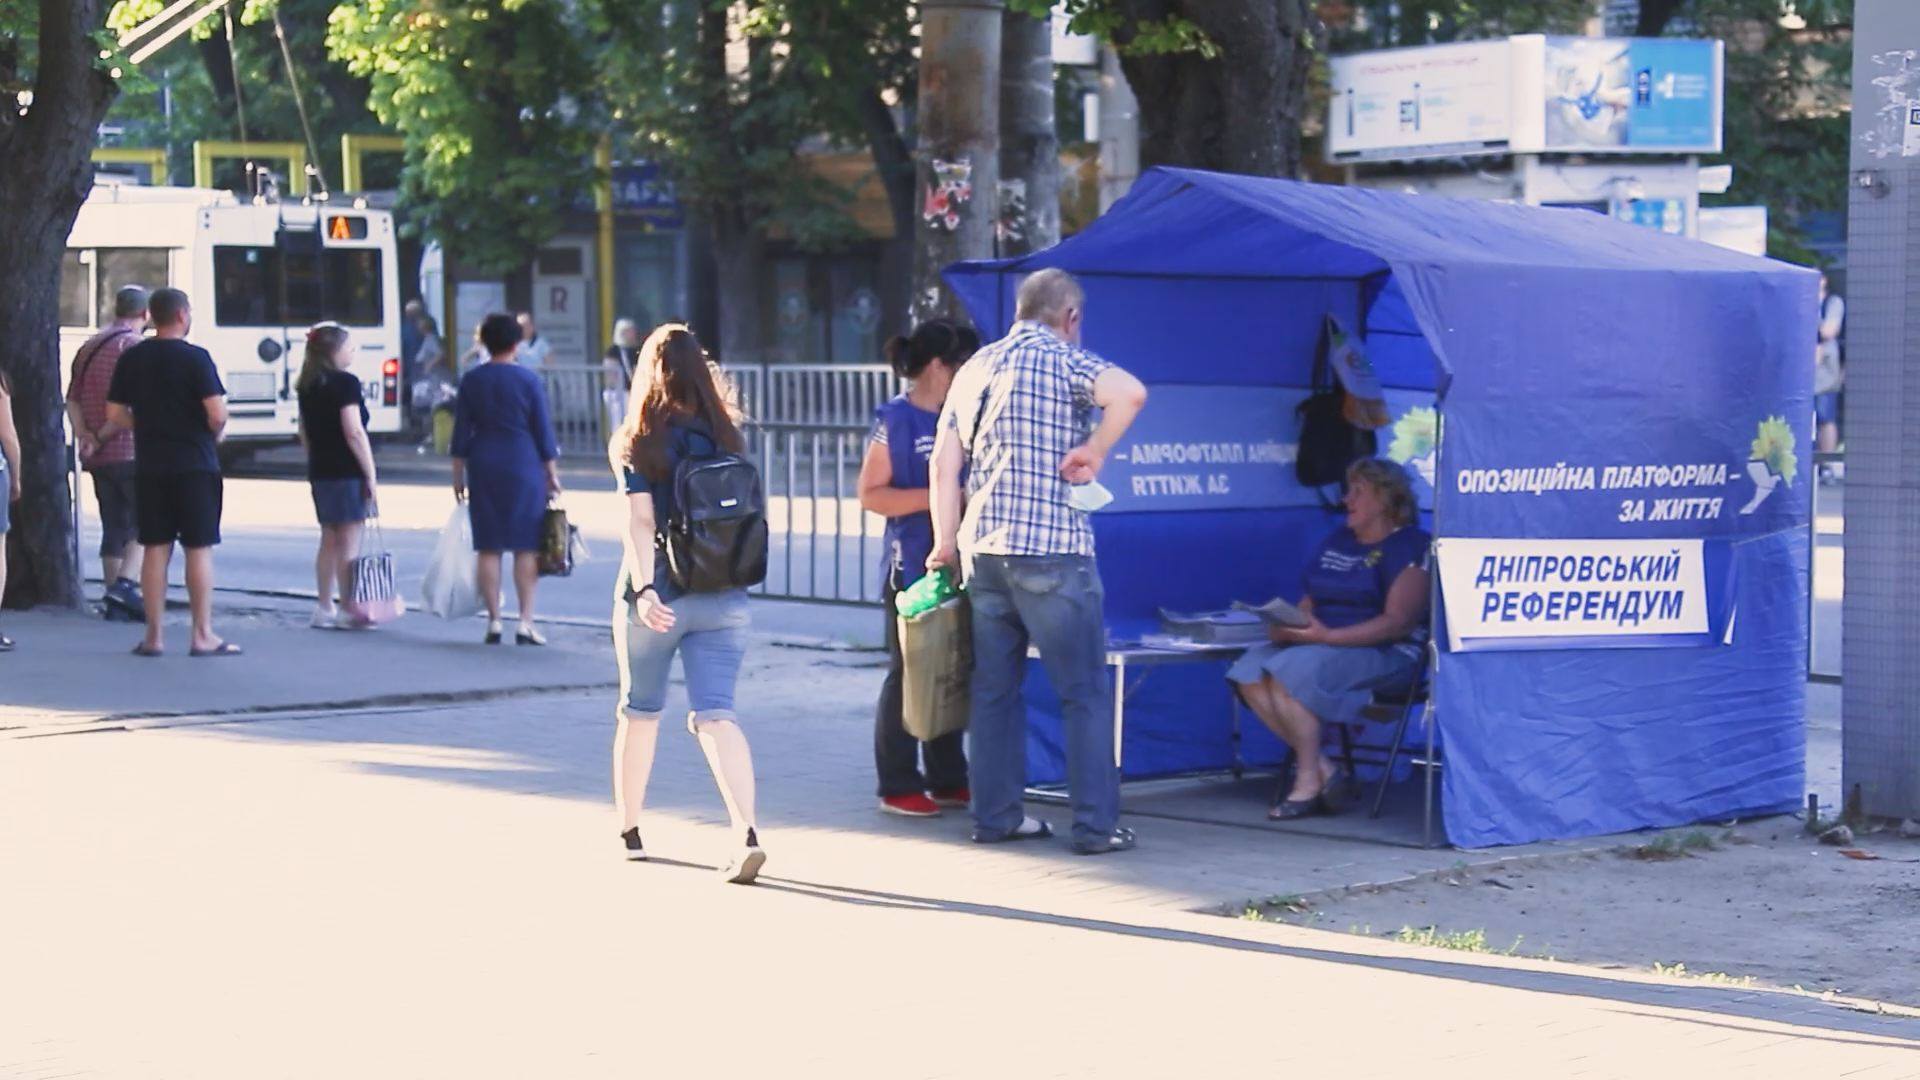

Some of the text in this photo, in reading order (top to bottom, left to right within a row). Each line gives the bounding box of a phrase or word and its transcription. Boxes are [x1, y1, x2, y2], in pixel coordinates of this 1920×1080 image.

[1458, 462, 1595, 495] ОПОЗИЦІЙНА
[1618, 498, 1723, 522] ЗА ЖИТТЯ
[1475, 549, 1682, 588] ДНІПРОВСЬКИЙ
[1481, 590, 1684, 627] РЕФЕРЕНДУМ
